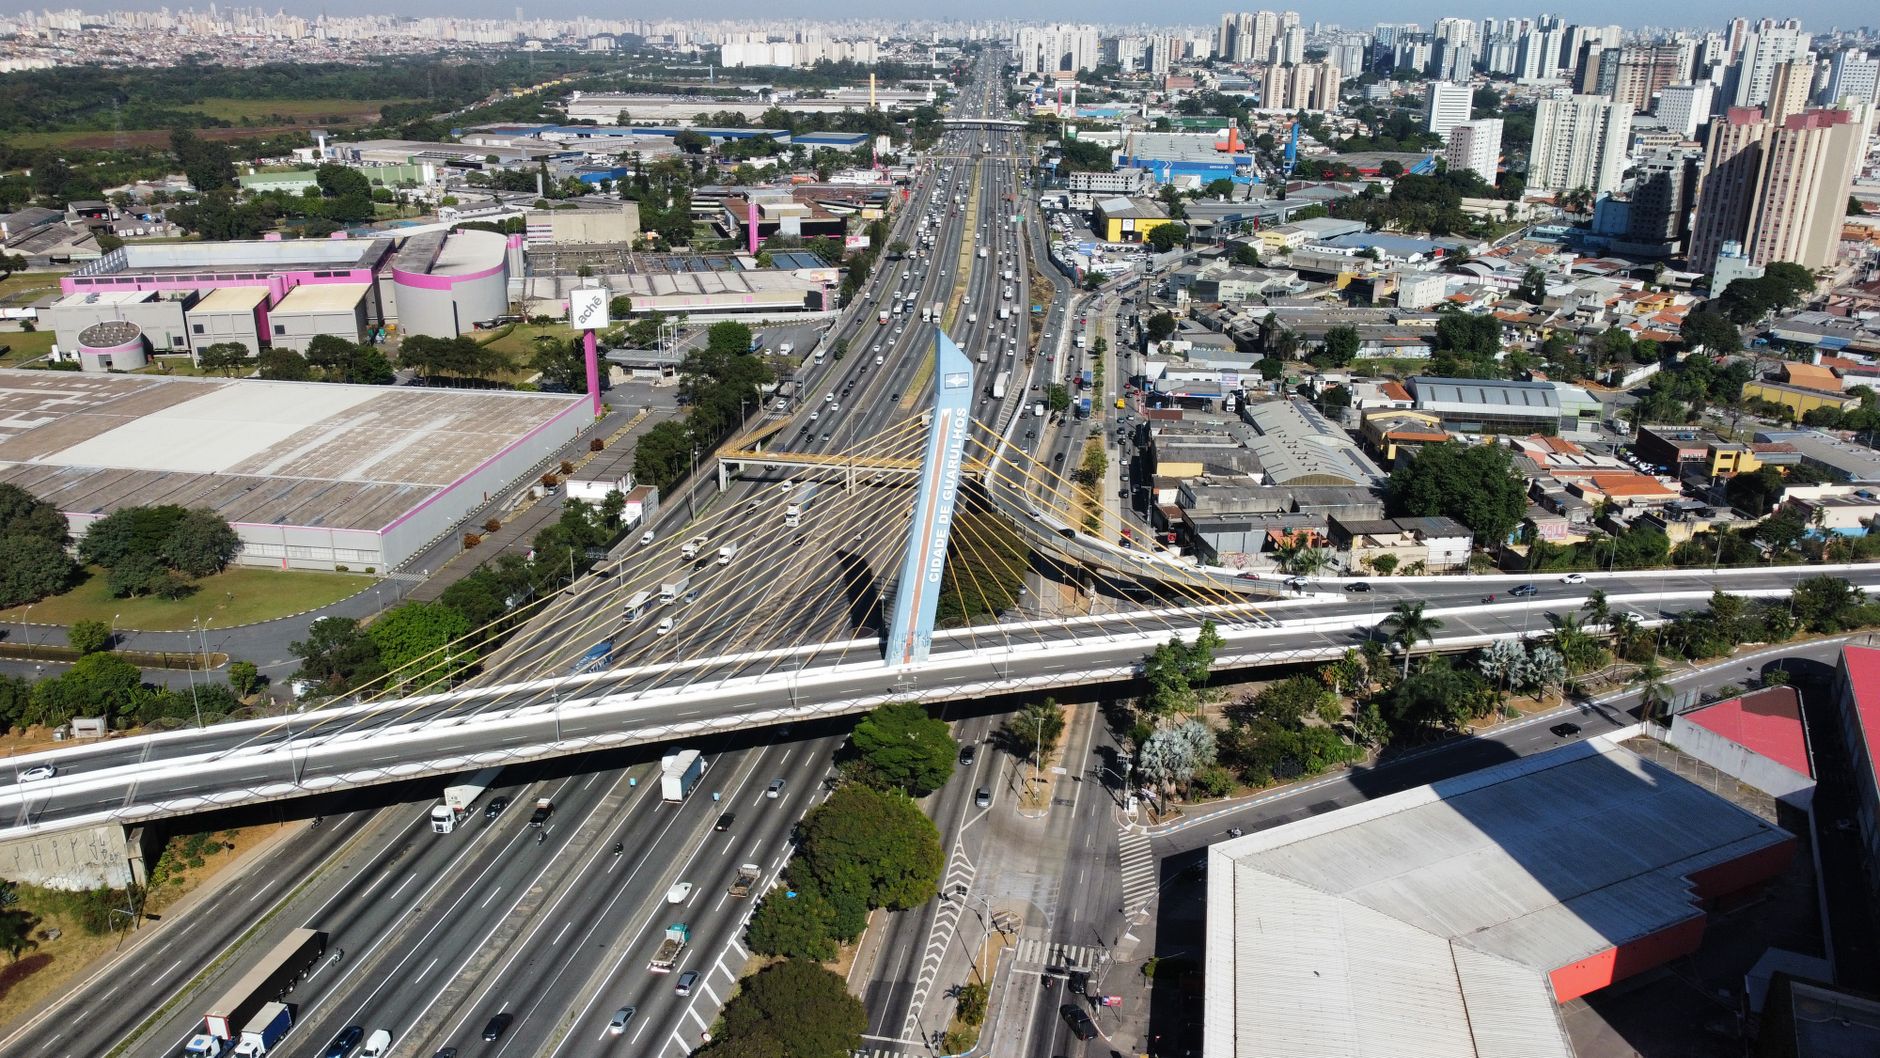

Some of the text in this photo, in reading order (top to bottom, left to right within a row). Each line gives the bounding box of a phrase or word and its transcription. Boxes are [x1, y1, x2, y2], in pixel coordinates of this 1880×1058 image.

[928, 407, 967, 583] CIDADE DE GUARULHOS
